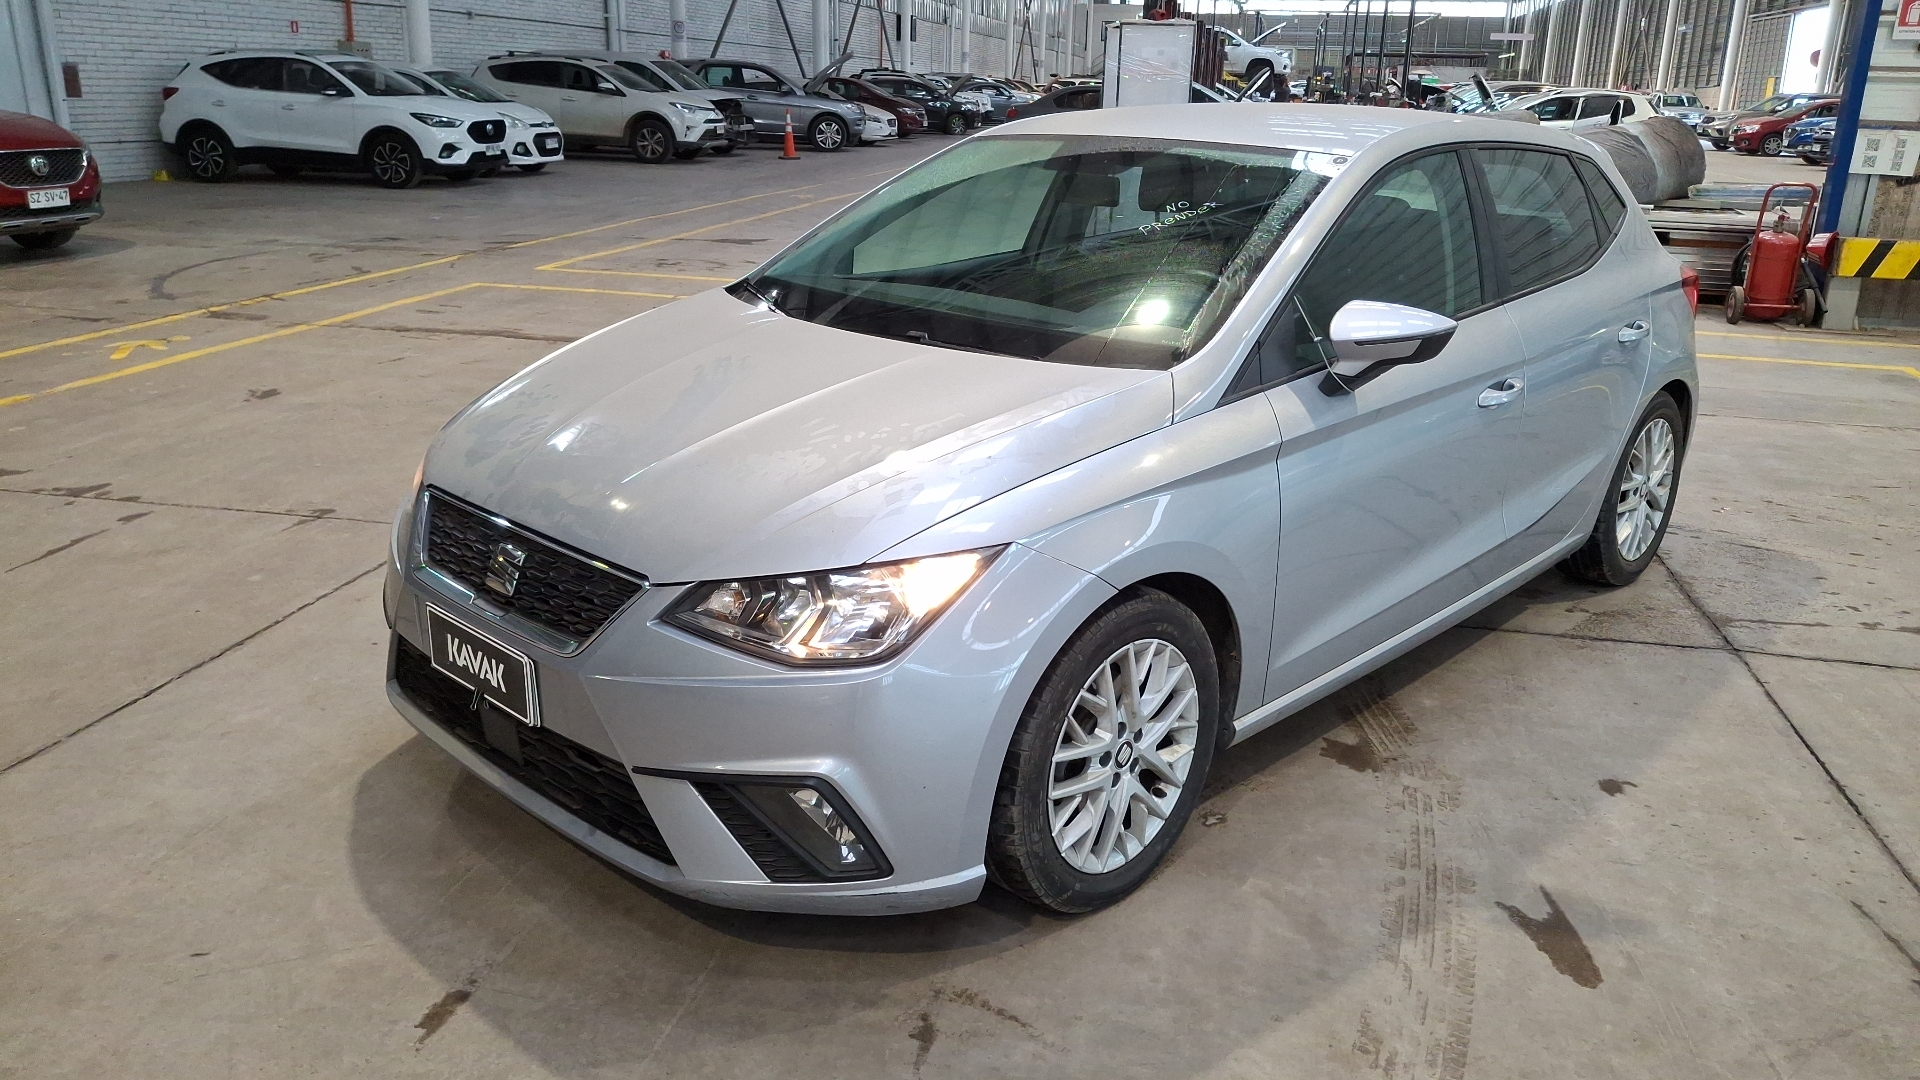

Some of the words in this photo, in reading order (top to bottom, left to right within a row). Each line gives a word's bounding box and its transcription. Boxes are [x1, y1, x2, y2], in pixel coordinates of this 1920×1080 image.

[30, 192, 42, 204] SZ
[1166, 201, 1190, 213] NO
[447, 633, 506, 693] KAVAK
